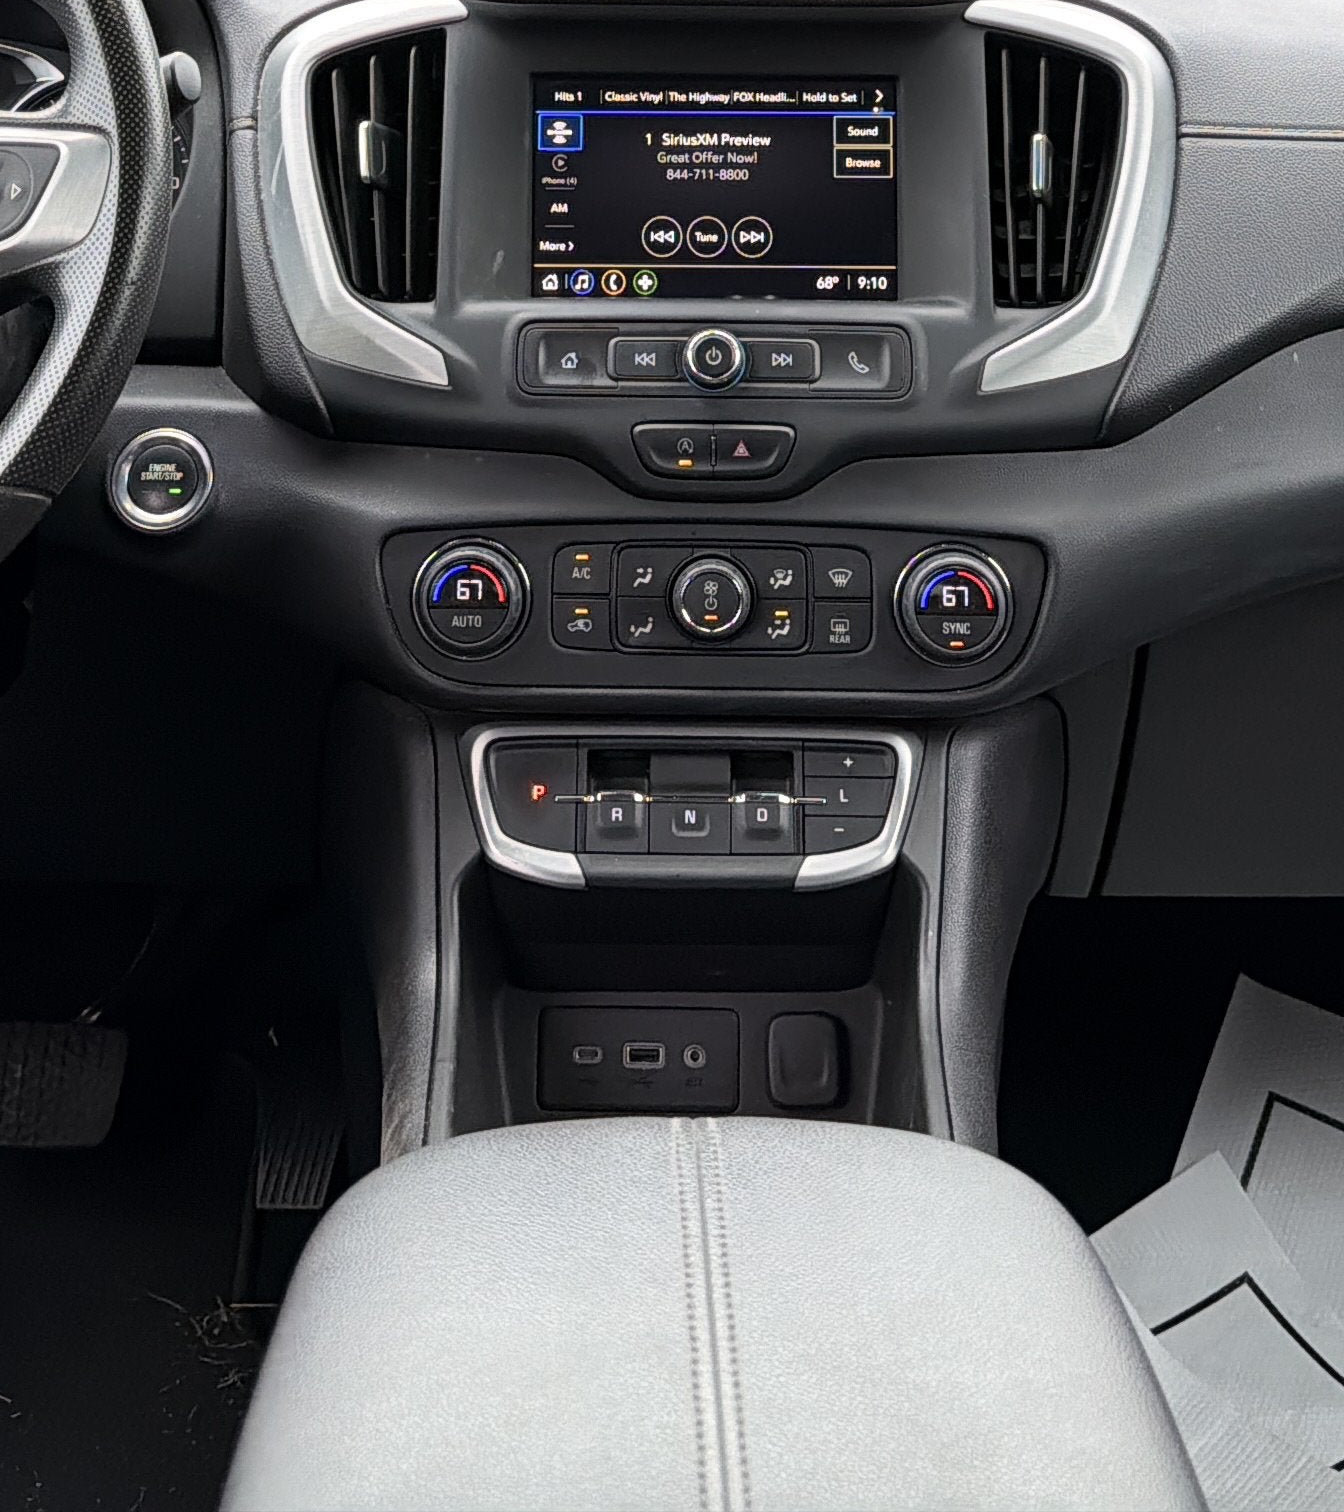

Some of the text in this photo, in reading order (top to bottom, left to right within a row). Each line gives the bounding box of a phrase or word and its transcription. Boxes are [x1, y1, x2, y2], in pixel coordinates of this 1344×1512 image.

[554, 90, 575, 102] Hits
[604, 91, 663, 104] Classic Vinyl
[668, 91, 730, 105] The Highway
[733, 91, 754, 102] FOX
[802, 92, 857, 103] Hold to Set
[846, 125, 879, 137] Sound
[645, 133, 771, 147] 1 SiriusXM Preview
[656, 151, 759, 164] Great Offer Now!
[845, 157, 882, 168] Browse
[566, 176, 578, 186] (4)
[666, 169, 749, 181] 844-711-8800
[550, 203, 569, 214] AM
[694, 231, 719, 243] Tune
[539, 240, 566, 252] More
[857, 276, 888, 290] 9:10
[148, 463, 177, 472] ENGINE
[140, 471, 184, 481] START/STOP
[572, 566, 592, 580] A/C
[456, 580, 483, 600] 67
[942, 587, 969, 607] 67
[451, 614, 483, 628] AUTO
[942, 622, 972, 636] SYNC
[829, 634, 851, 645] REAR
[532, 784, 546, 800] P
[839, 789, 849, 804] L
[612, 807, 623, 823] R
[685, 809, 696, 825] N
[757, 807, 768, 823] D
